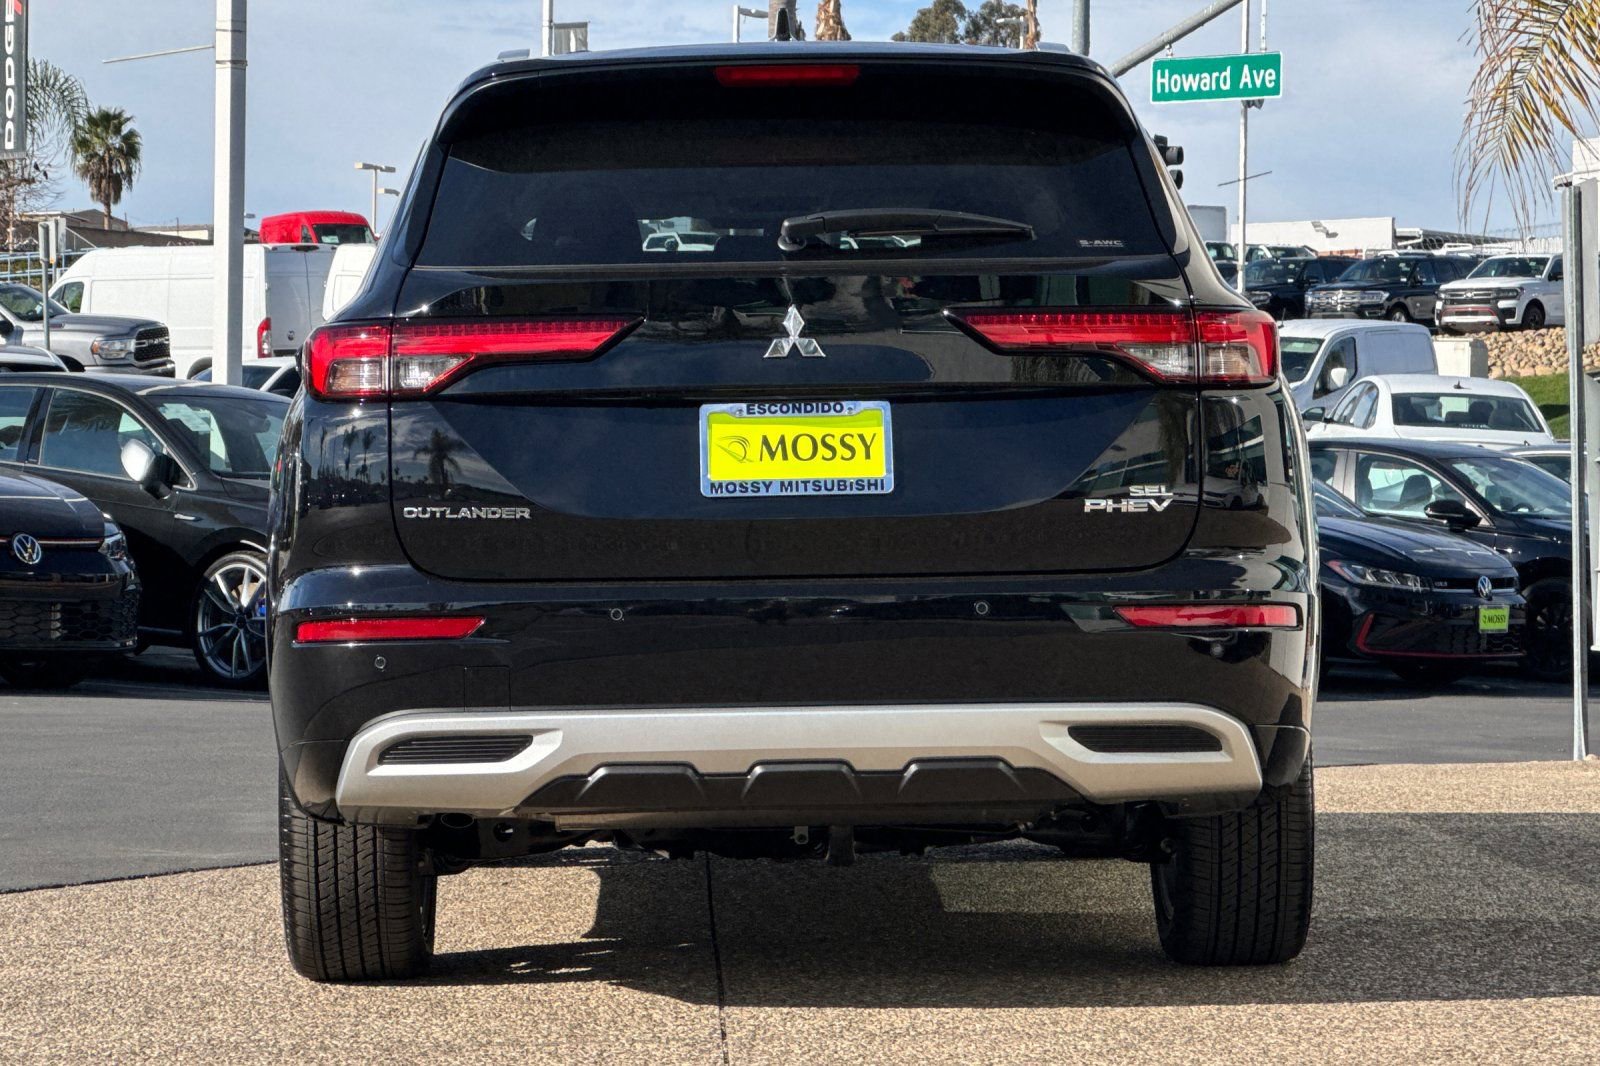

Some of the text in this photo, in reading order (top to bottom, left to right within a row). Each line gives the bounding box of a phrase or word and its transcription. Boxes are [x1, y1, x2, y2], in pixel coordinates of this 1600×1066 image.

[5, 0, 15, 150] DODGE
[1156, 64, 1276, 94] Howard Ave
[746, 402, 844, 415] ESCONDIDO
[759, 433, 877, 462] MOSSY
[709, 478, 885, 494] MOSSY MITSUBISHI
[1129, 485, 1173, 496] SEL
[403, 506, 532, 519] OUTLANDER
[1084, 498, 1173, 513] PHEV
